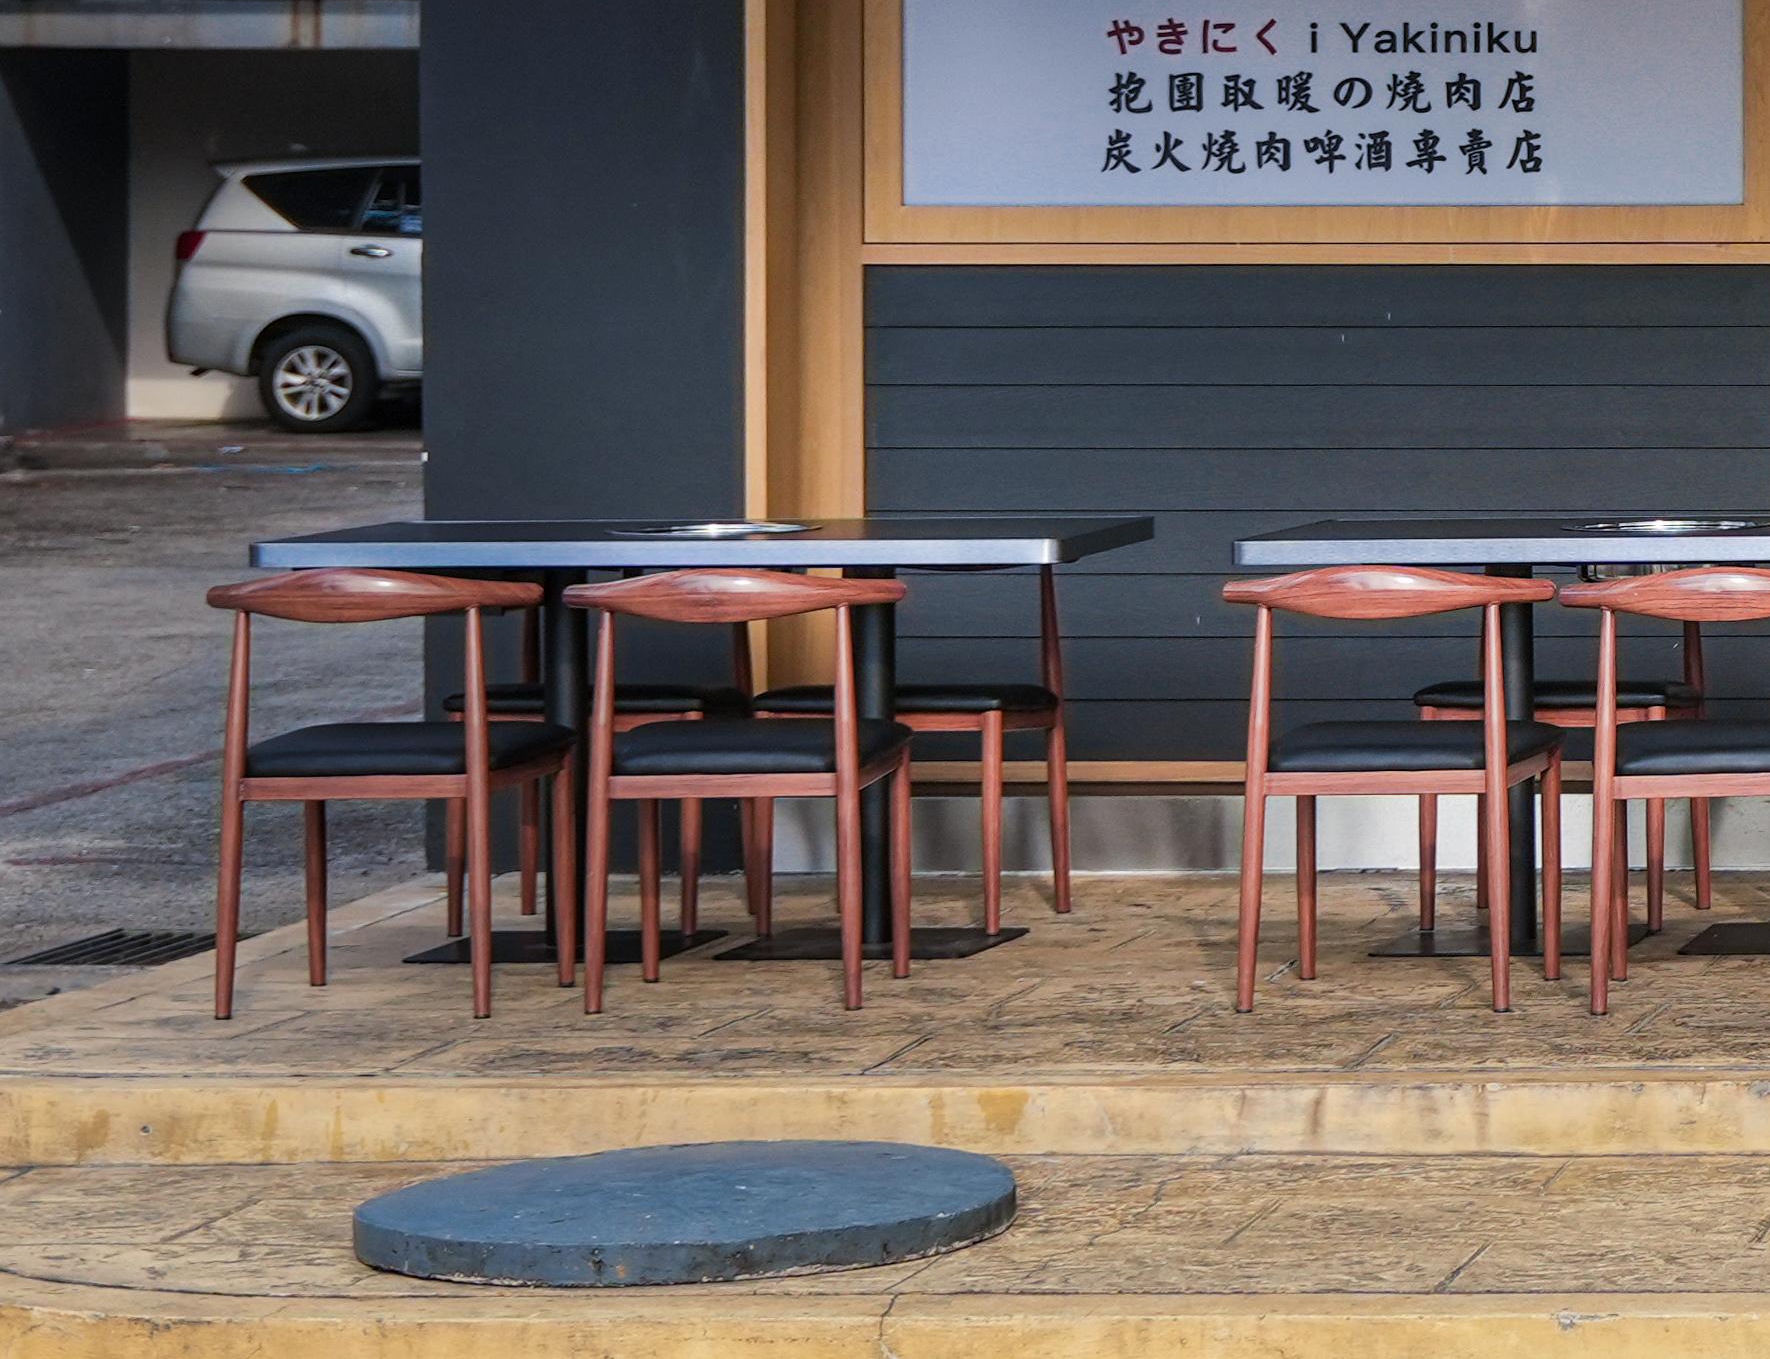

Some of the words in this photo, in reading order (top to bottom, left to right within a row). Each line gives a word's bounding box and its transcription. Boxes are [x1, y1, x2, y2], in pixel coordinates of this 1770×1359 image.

[1107, 18, 1277, 55] やきにく
[1310, 22, 1318, 53] i
[1340, 22, 1536, 53] Yakiniku
[1109, 71, 1535, 113] 抱團取暖の燒肉店
[1102, 129, 1542, 174] 炭火燒肉啤酒專賣店
